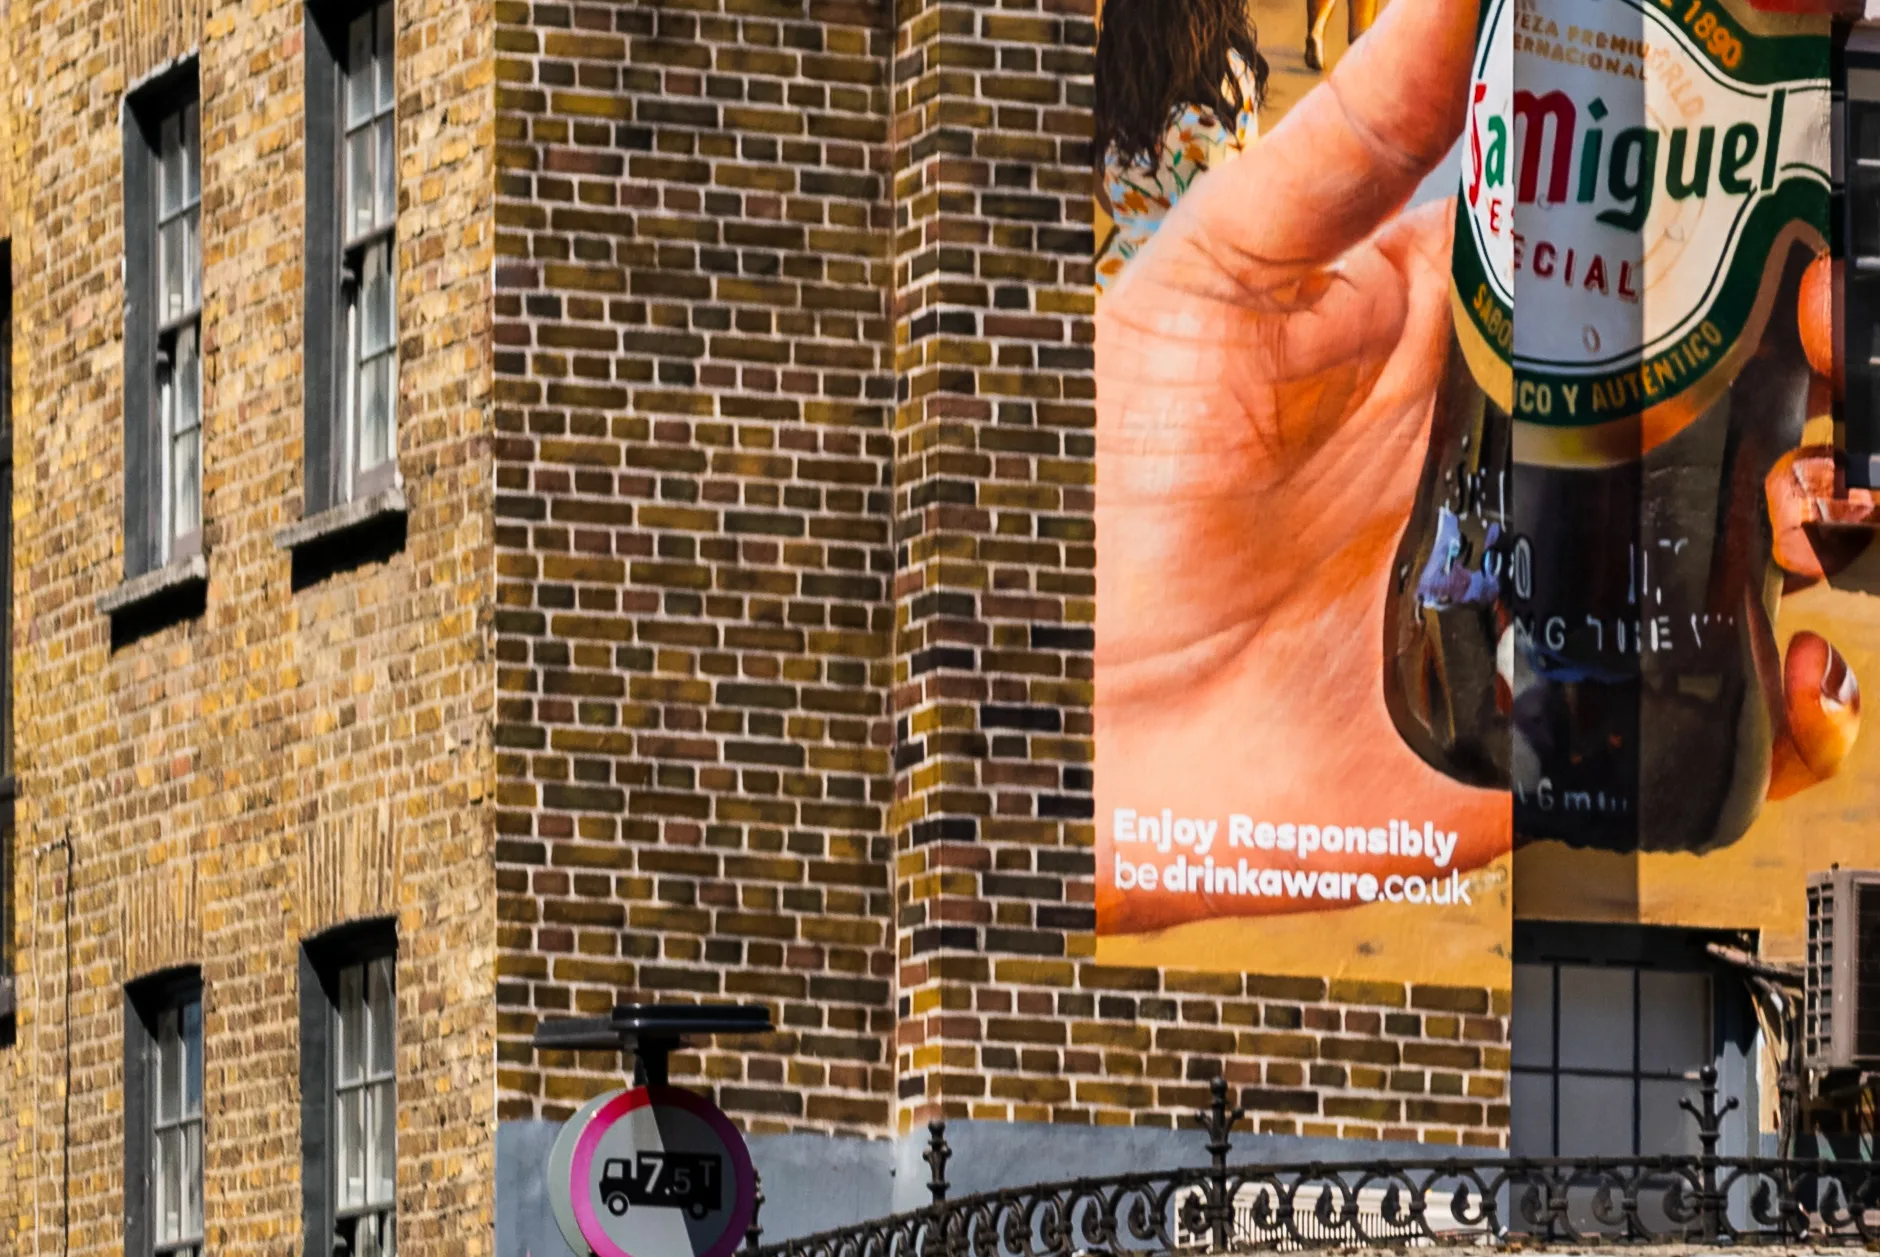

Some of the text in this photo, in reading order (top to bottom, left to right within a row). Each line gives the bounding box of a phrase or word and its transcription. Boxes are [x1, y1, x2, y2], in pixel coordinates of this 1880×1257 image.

[1514, 33, 1648, 82] ERNACIONAL
[1513, 380, 1552, 416] ICO
[1561, 383, 1579, 417] Y
[1113, 808, 1458, 867] Enjoy Responsibly
